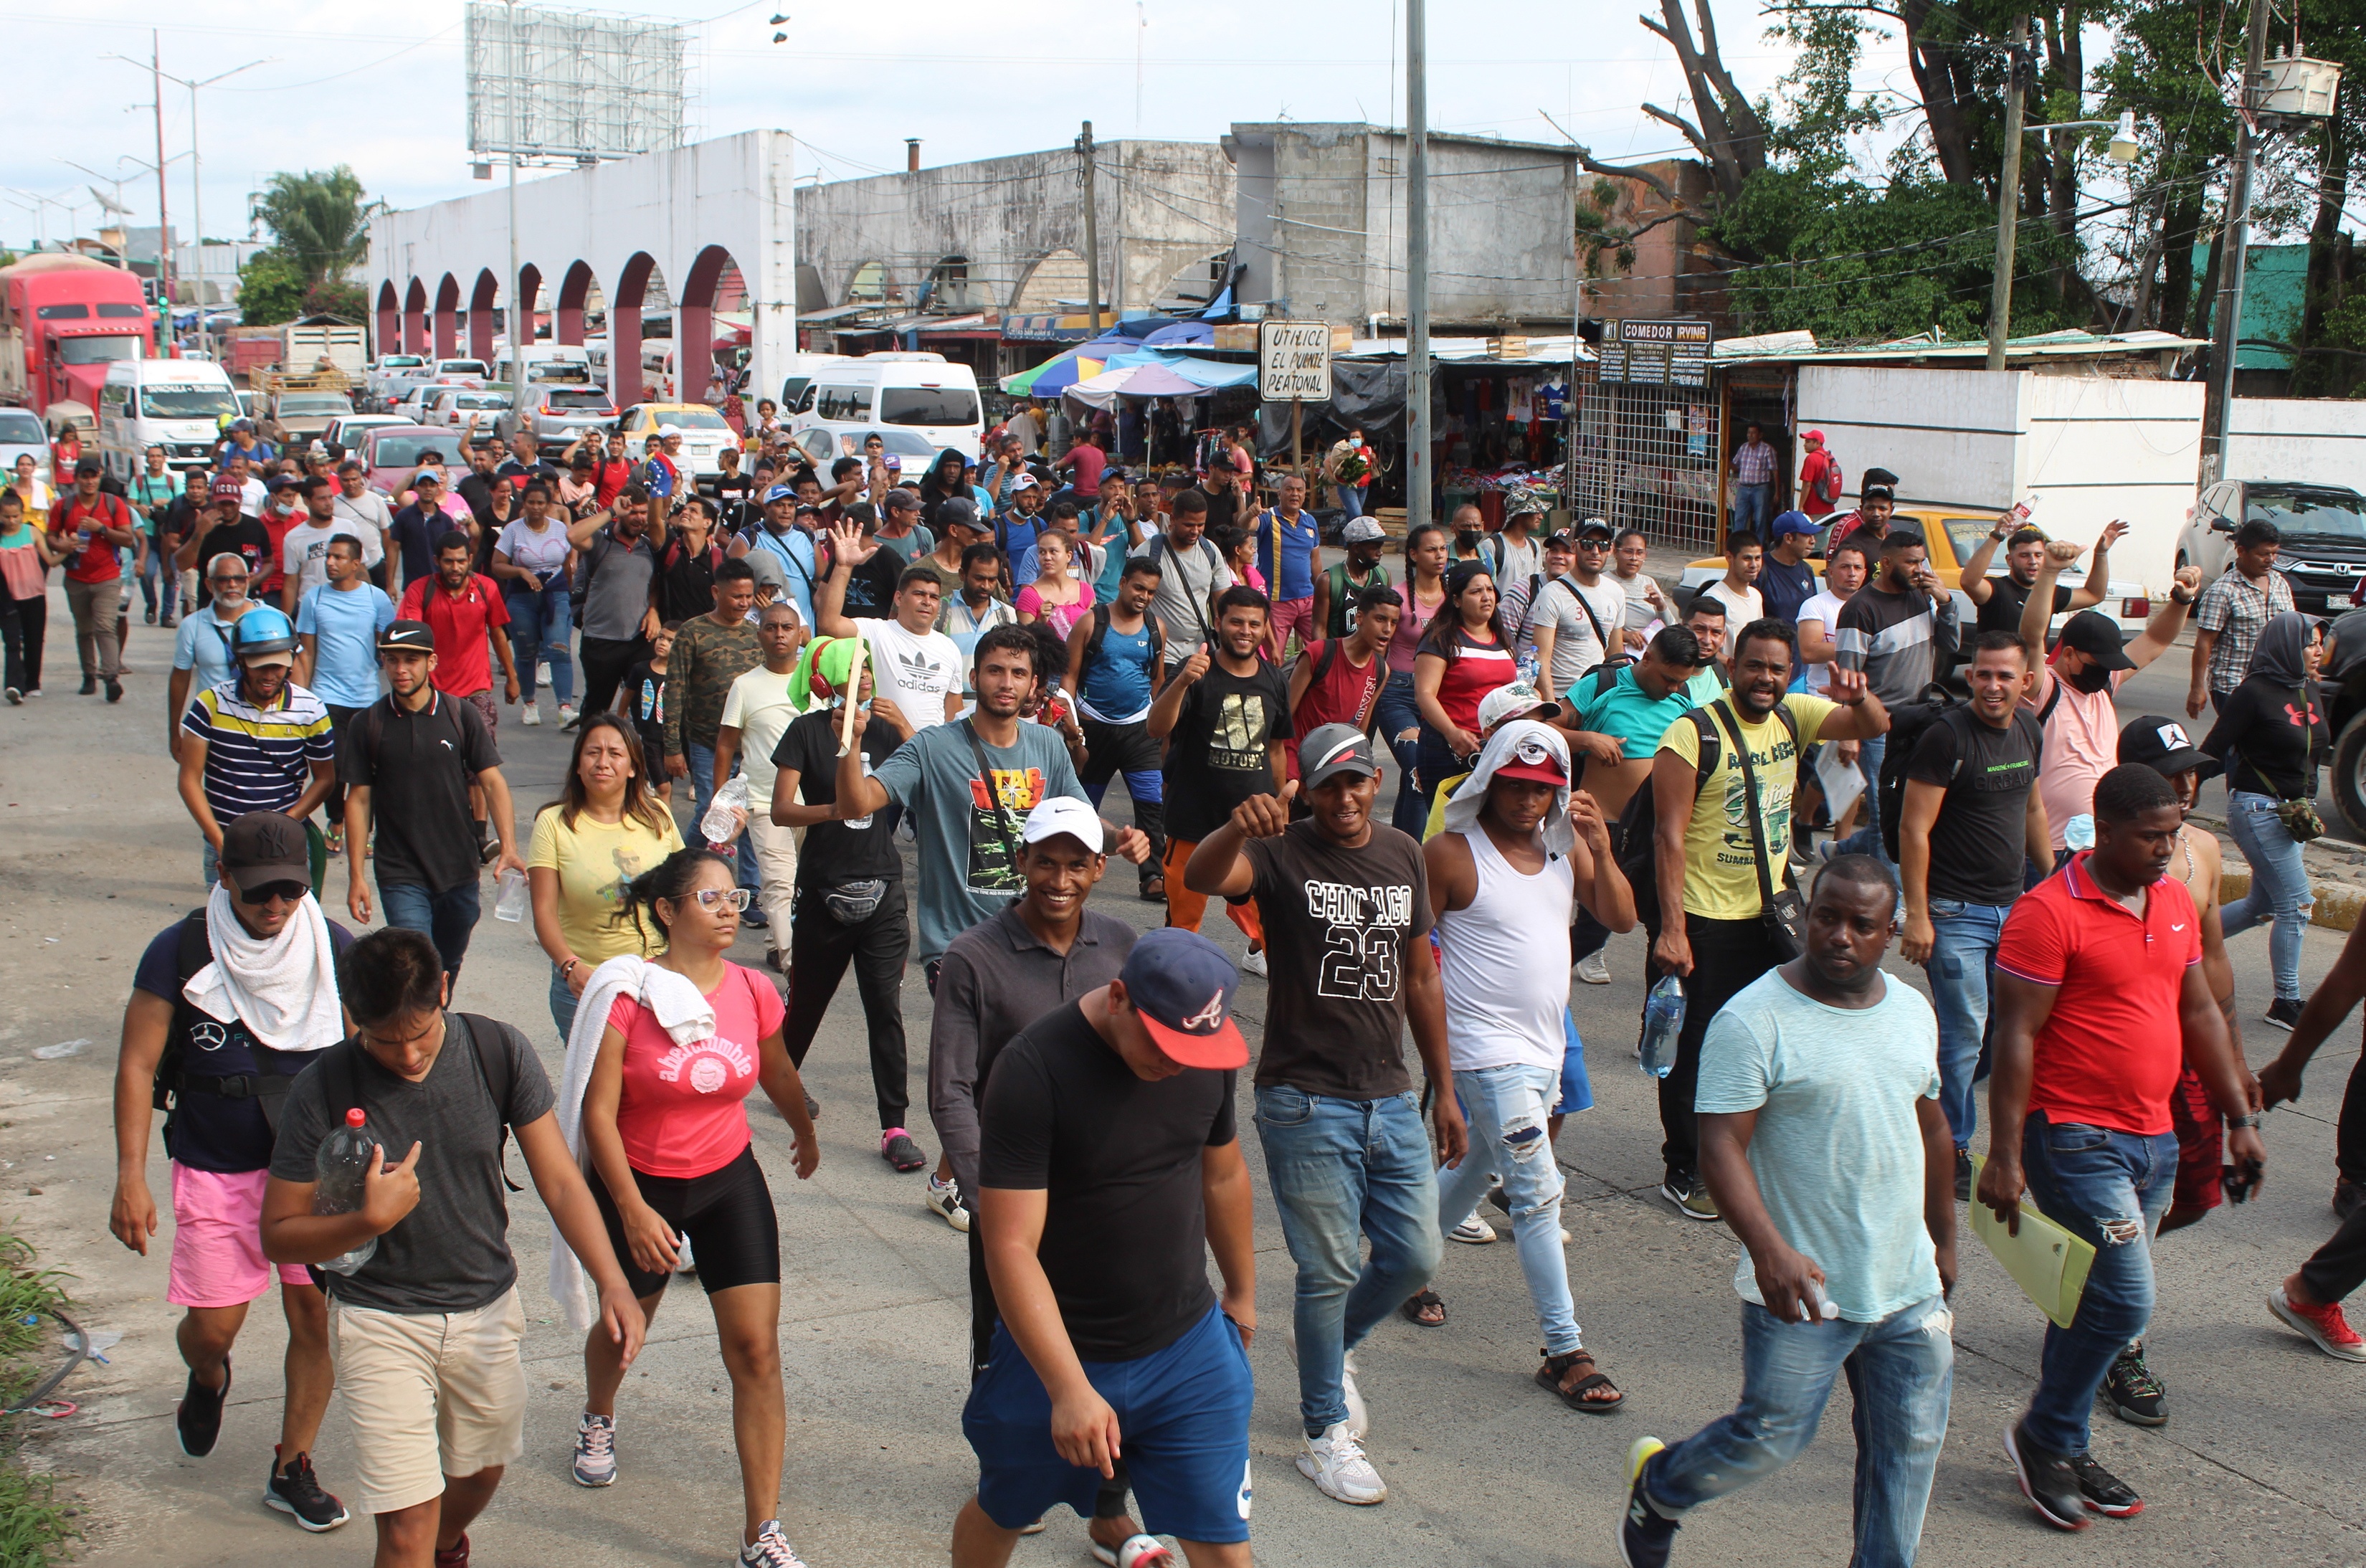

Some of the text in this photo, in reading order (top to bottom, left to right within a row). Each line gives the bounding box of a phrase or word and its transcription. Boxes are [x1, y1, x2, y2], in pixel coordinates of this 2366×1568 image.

[1273, 328, 1324, 346] UTILICE
[1625, 324, 1707, 340] COMEDOR IRVING
[1271, 351, 1324, 370] EL PUENTE
[1266, 374, 1322, 393] PEATONAL
[971, 430, 979, 439] 15
[216, 483, 239, 494] ICON
[1585, 517, 1606, 526] BOSS
[1574, 606, 1584, 621] 3
[897, 678, 941, 693] adidas
[1304, 878, 1412, 927] CHICAGO
[1318, 924, 1400, 1002] 23
[1182, 987, 1224, 1030] A
[656, 1035, 752, 1083] abercrombie
